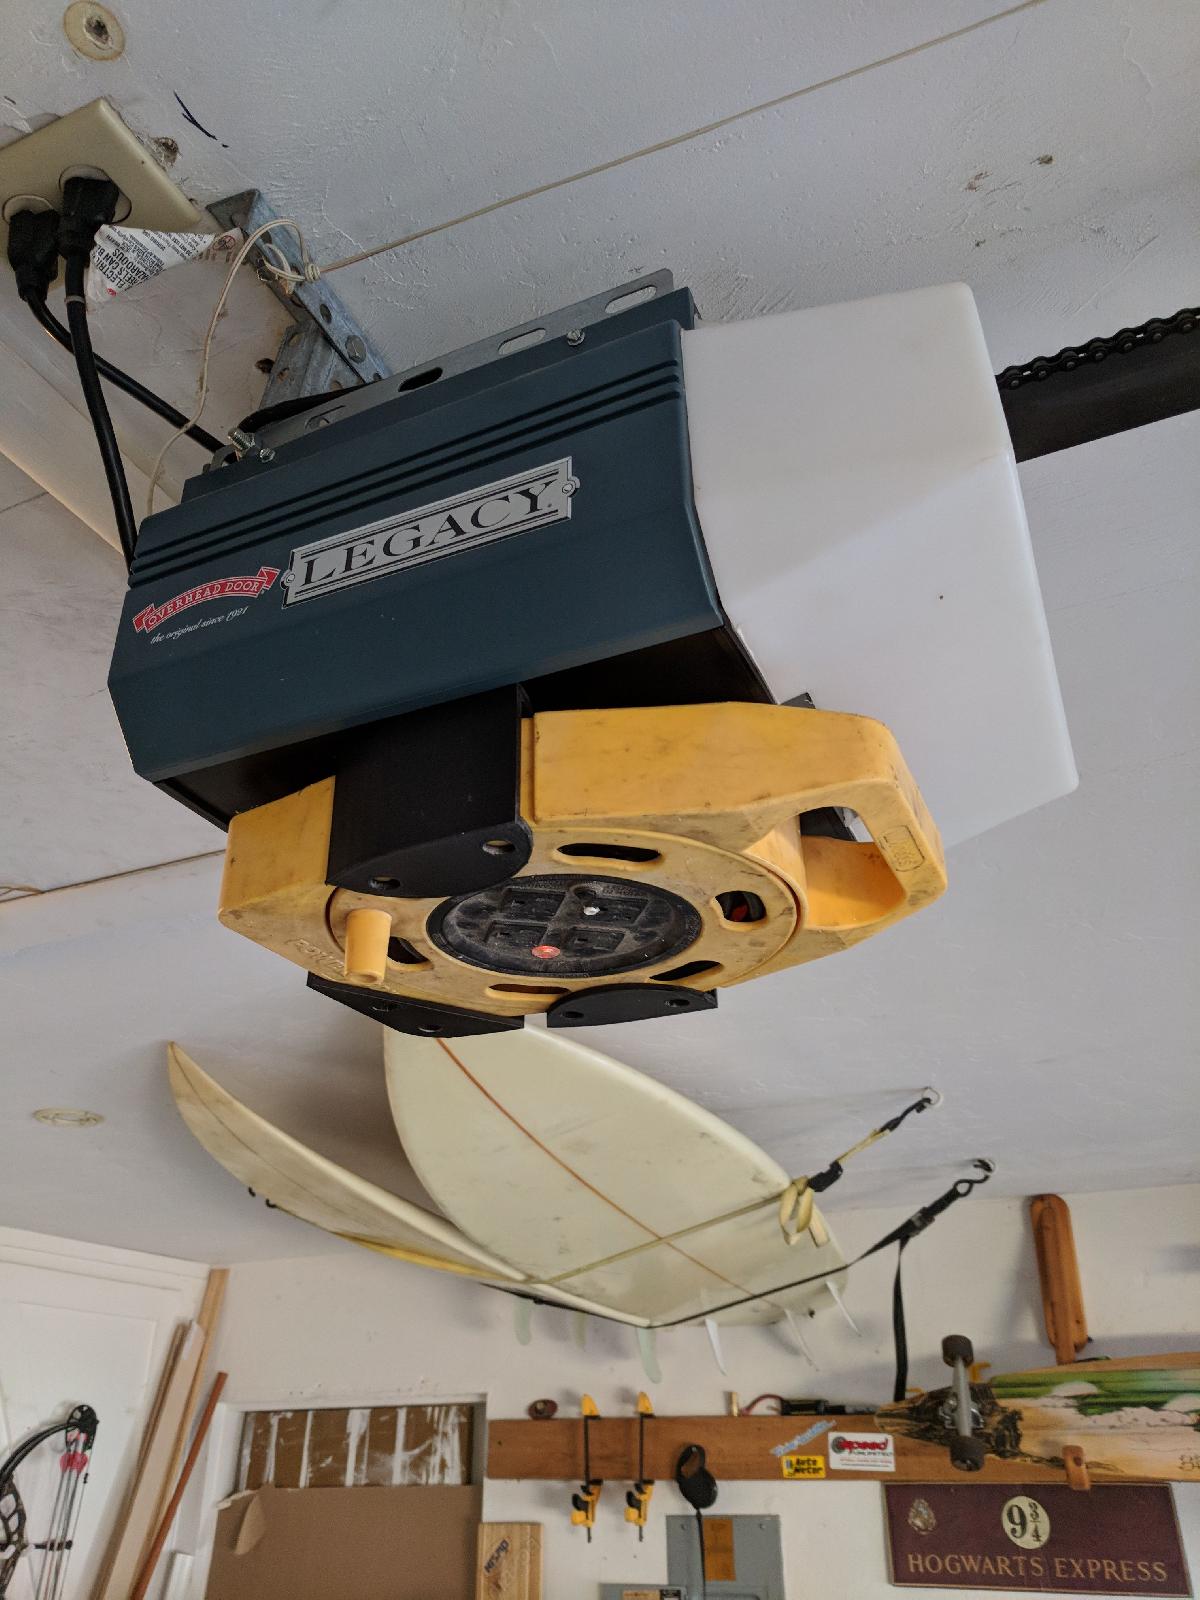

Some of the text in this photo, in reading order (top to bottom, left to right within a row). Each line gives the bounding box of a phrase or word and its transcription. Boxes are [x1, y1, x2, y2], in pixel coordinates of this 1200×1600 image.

[102, 252, 120, 270] CAN
[300, 478, 558, 587] LEGACY
[148, 581, 259, 626] OVERHEAD DOOR
[150, 605, 249, 645] the original since 1921
[907, 1553, 1168, 1582] HOGWARTS EXPRESS
